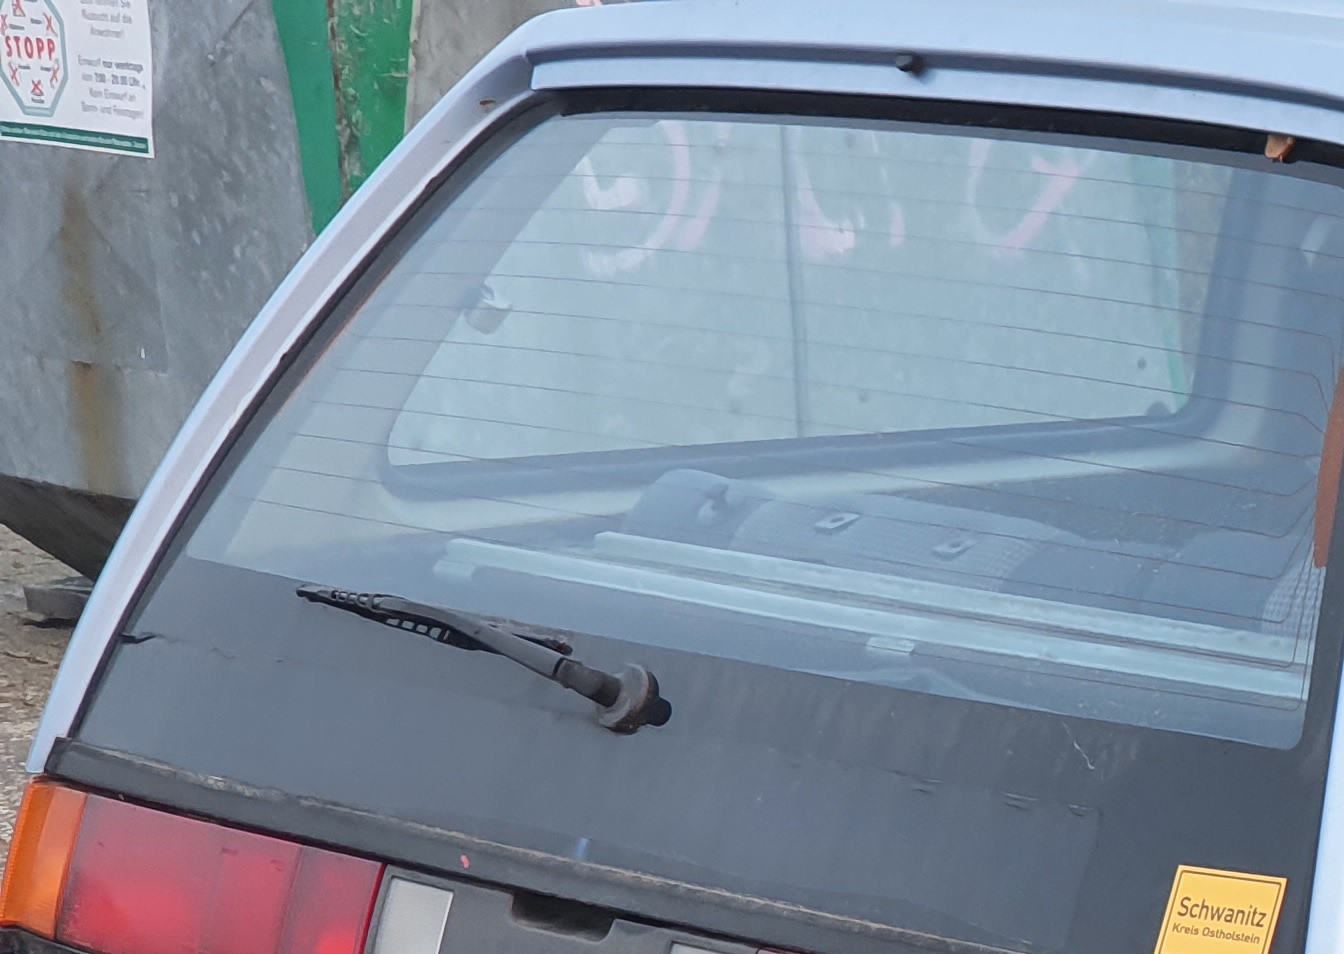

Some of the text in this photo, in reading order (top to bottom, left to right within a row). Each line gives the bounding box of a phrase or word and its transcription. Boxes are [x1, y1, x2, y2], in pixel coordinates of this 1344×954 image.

[5, 35, 56, 61] STOPP
[1177, 896, 1267, 928] Schwanitz
[1172, 922, 1261, 944] Kreis Ostholstein
